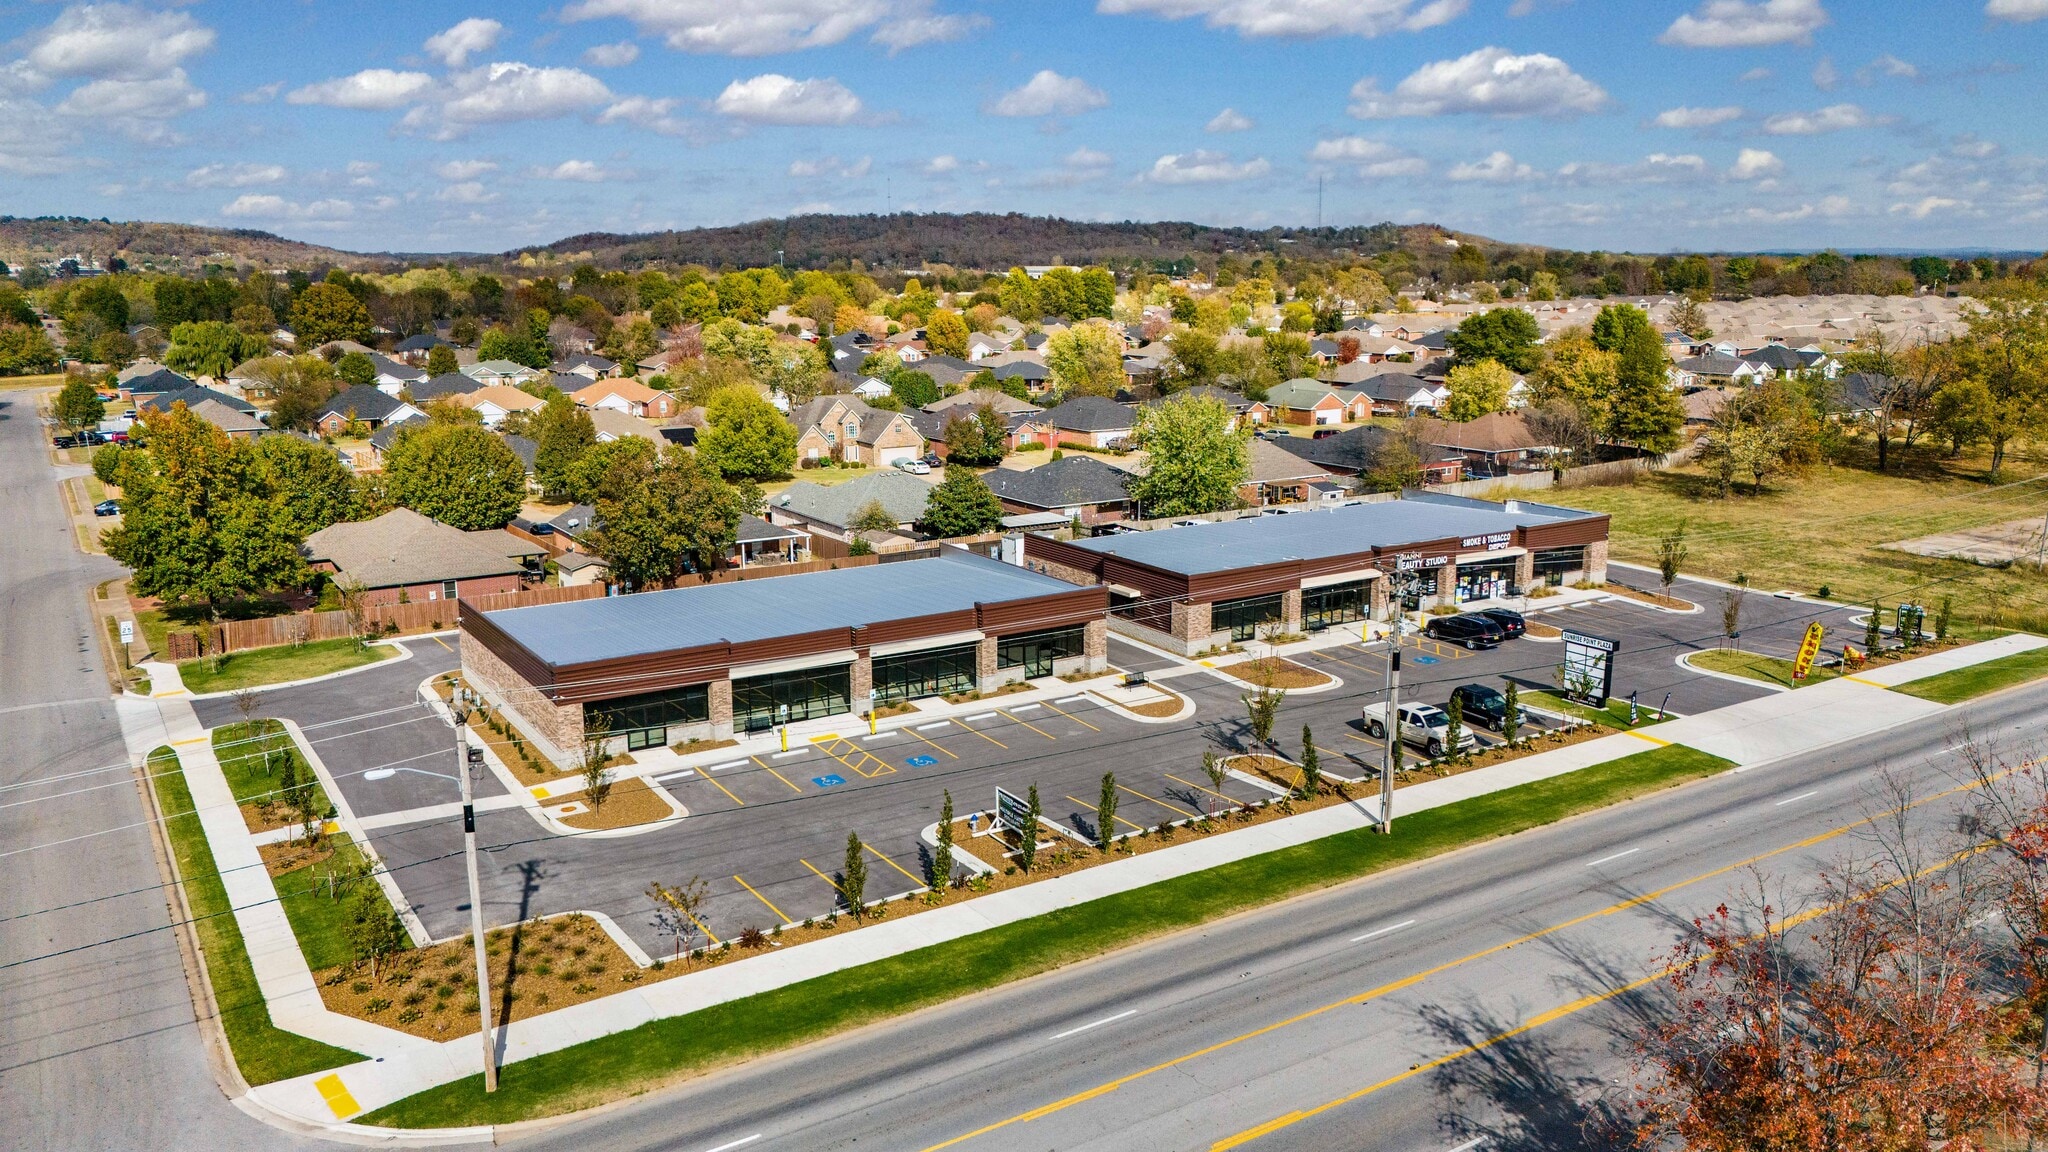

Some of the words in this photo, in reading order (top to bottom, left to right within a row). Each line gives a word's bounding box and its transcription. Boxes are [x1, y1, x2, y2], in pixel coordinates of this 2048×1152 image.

[1463, 537, 1481, 547] SMOKE
[1482, 536, 1487, 544] &
[1487, 533, 1511, 543] TOBACCO
[1488, 542, 1509, 550] DEPOT
[1401, 559, 1423, 570] EAUTY
[1425, 556, 1448, 566] STUDIO
[1564, 633, 1582, 643] SUNRISE
[1583, 637, 1597, 645] POINT
[1597, 641, 1611, 649] PLAZA
